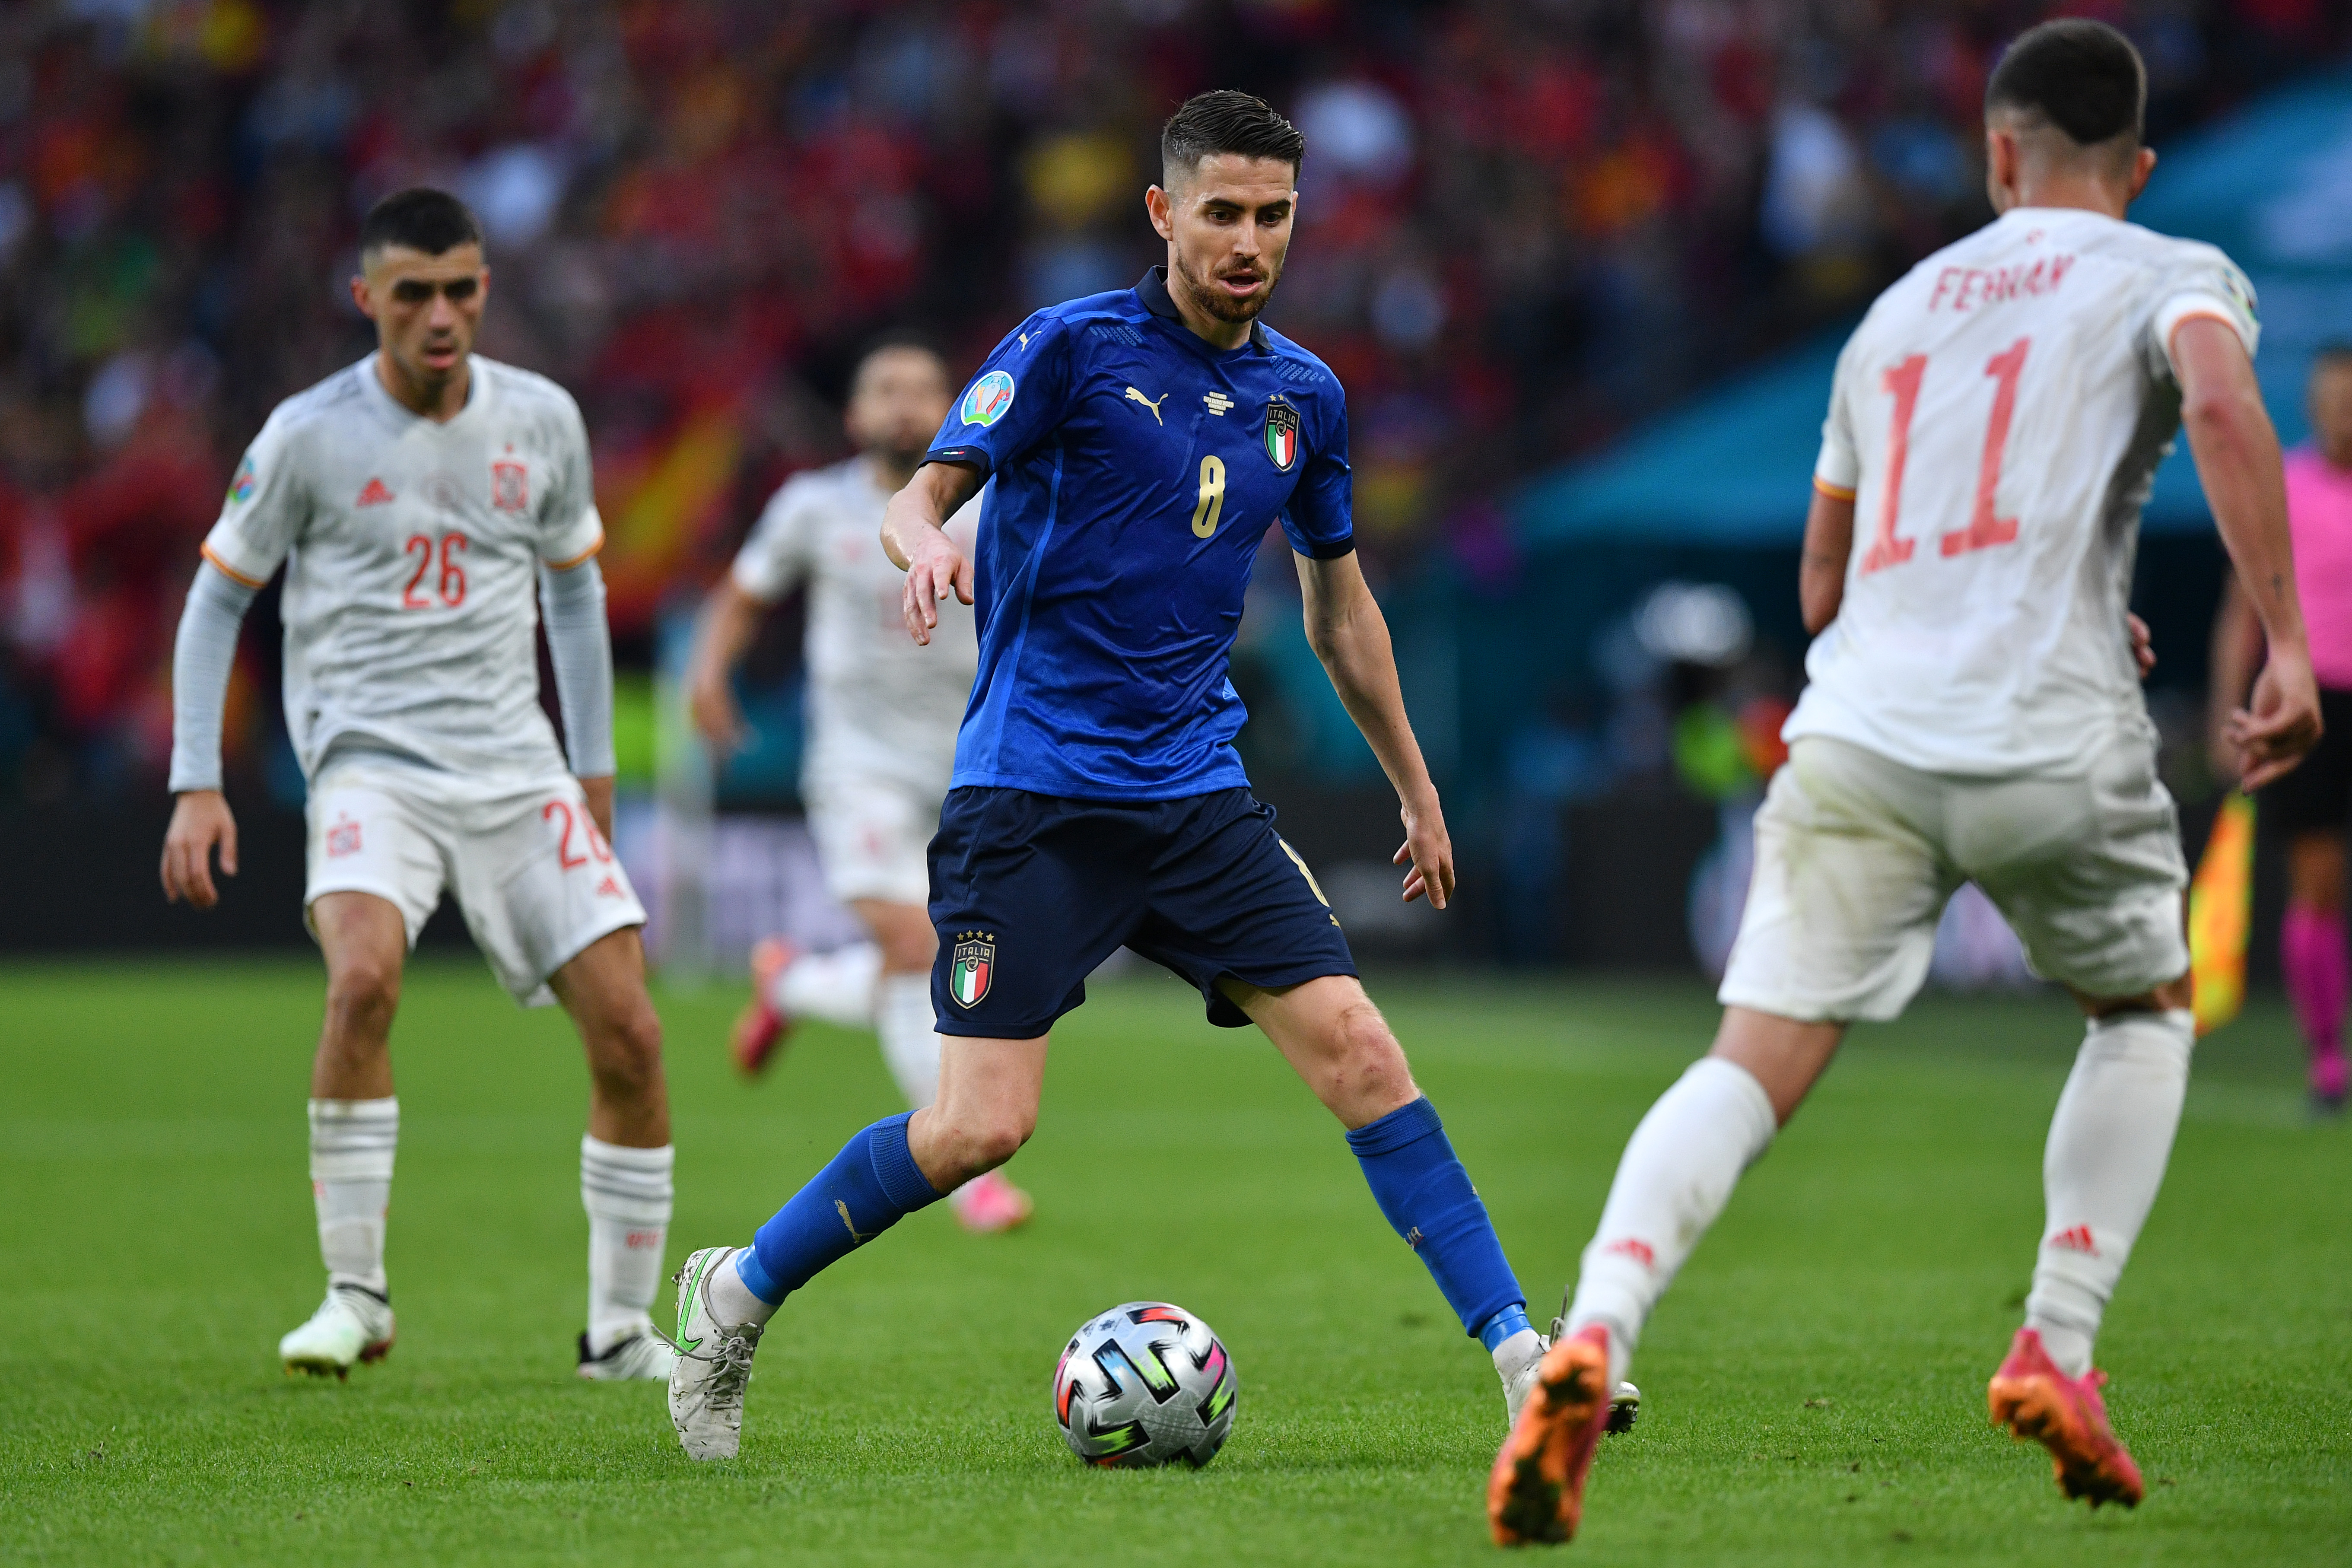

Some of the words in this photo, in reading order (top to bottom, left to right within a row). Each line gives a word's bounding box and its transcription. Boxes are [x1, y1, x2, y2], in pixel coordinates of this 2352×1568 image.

[1269, 409, 1296, 426] ITALIA
[1859, 335, 2031, 579] 11
[1192, 455, 1225, 538] 8
[402, 532, 467, 610] 26
[958, 947, 990, 958] ITALIA
